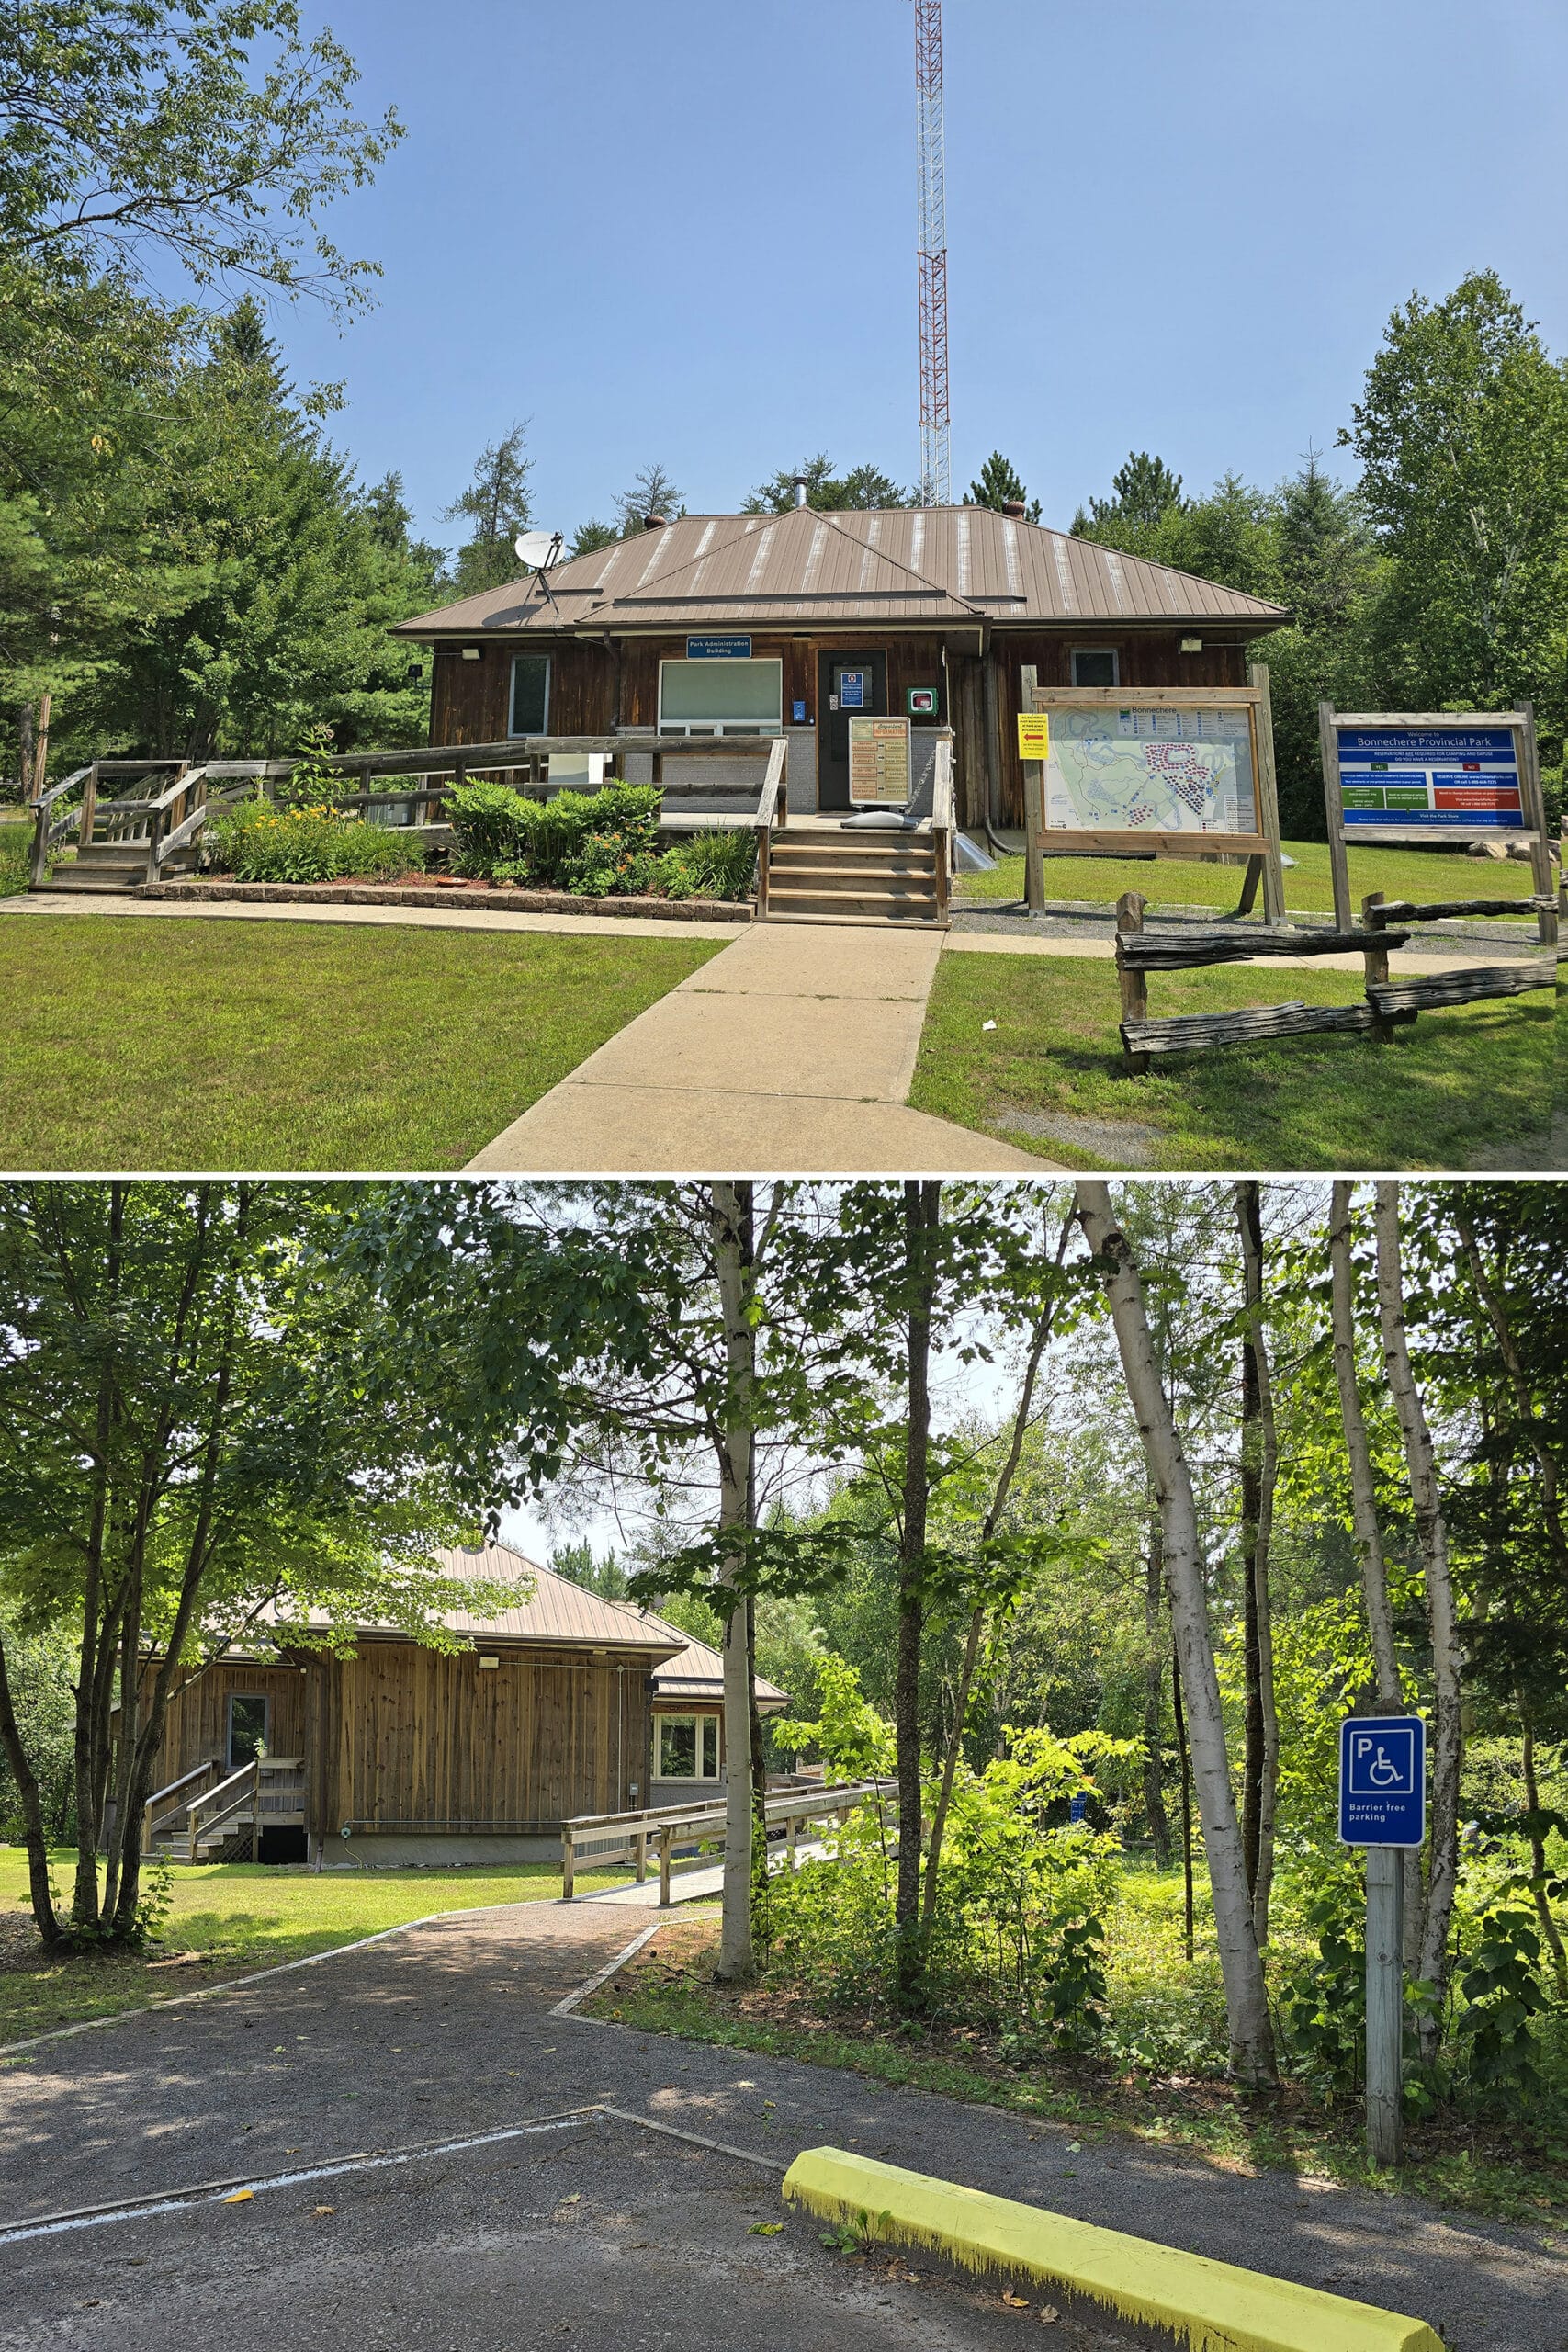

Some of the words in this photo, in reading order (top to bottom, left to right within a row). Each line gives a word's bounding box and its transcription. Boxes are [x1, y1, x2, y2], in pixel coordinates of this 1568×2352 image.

[1358, 737, 1416, 746] Bonnechere
[1419, 737, 1466, 746] Provincial
[1469, 737, 1491, 746] Park
[1357, 1738, 1373, 1758] P
[1349, 1813, 1386, 1822] parking
